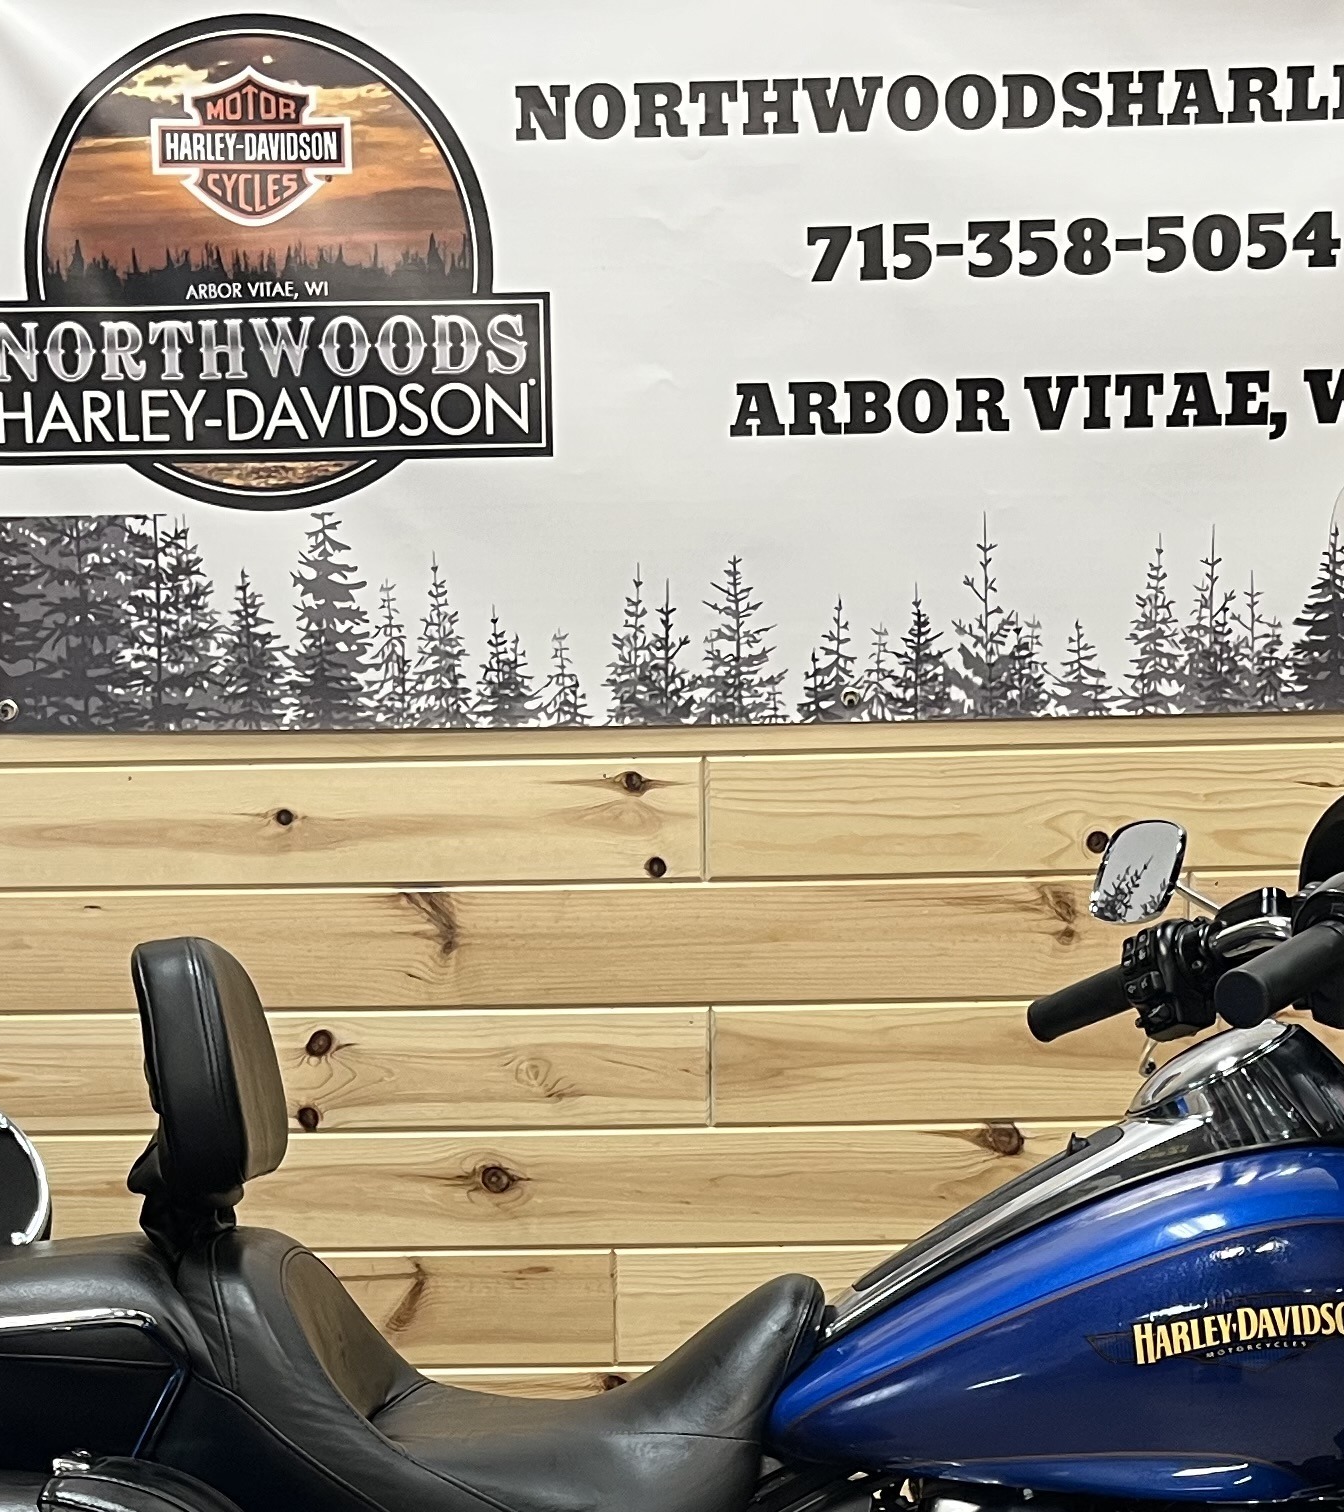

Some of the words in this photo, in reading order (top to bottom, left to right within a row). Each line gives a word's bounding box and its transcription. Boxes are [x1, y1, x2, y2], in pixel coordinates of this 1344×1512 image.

[206, 85, 296, 121] MOTOR
[165, 131, 338, 162] HARLEY-DAVIDSON
[207, 173, 298, 212] CYCLES
[807, 211, 1341, 282] 715-358-5054
[186, 283, 242, 299] ARBOR
[247, 281, 299, 299] VITAE,
[305, 281, 329, 296] WI
[730, 377, 1010, 438] ARBOR
[1024, 371, 1287, 440] VITAE,
[1206, 1341, 1307, 1358] MOTORCYCLES
